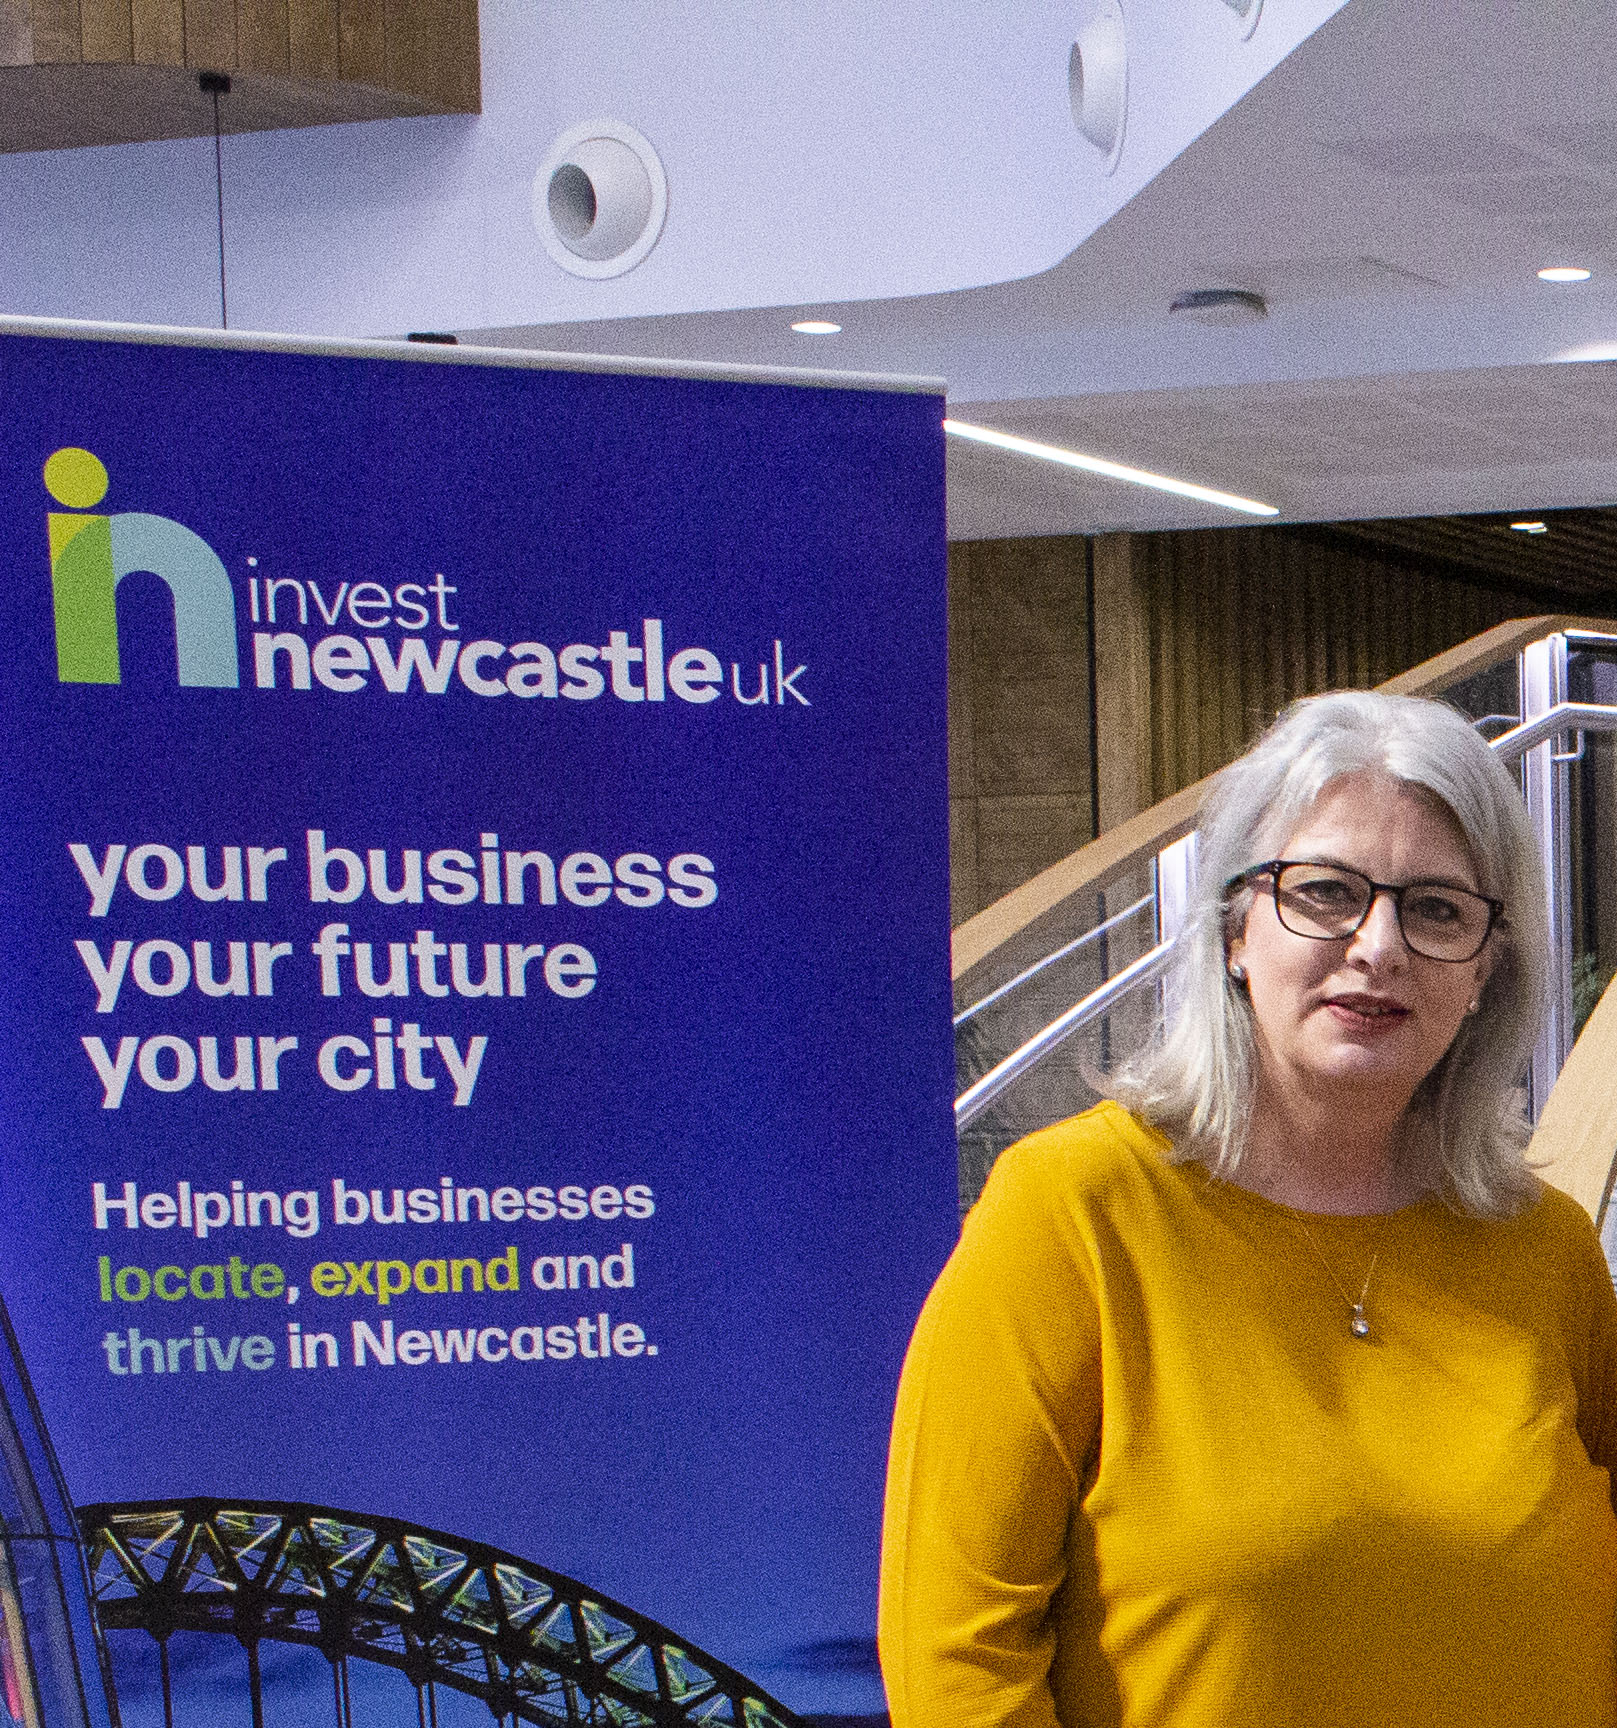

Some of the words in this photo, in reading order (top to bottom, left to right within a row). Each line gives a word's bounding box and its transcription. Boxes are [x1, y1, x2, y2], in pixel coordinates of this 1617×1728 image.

[247, 556, 460, 632] invest
[253, 618, 725, 705] newcastle
[732, 639, 811, 706] uk
[68, 842, 288, 918] your
[306, 828, 720, 909] business
[74, 938, 295, 1014] your
[311, 922, 599, 1000] future
[81, 1034, 300, 1110] your
[317, 1016, 489, 1107] city
[92, 1179, 322, 1239] Helping
[332, 1176, 657, 1226] businesses
[97, 1255, 301, 1307] locate,
[309, 1245, 521, 1306] expand
[531, 1242, 637, 1292] and
[101, 1325, 276, 1376] thrive
[287, 1321, 341, 1371] in
[351, 1312, 661, 1370] Newcastle.
